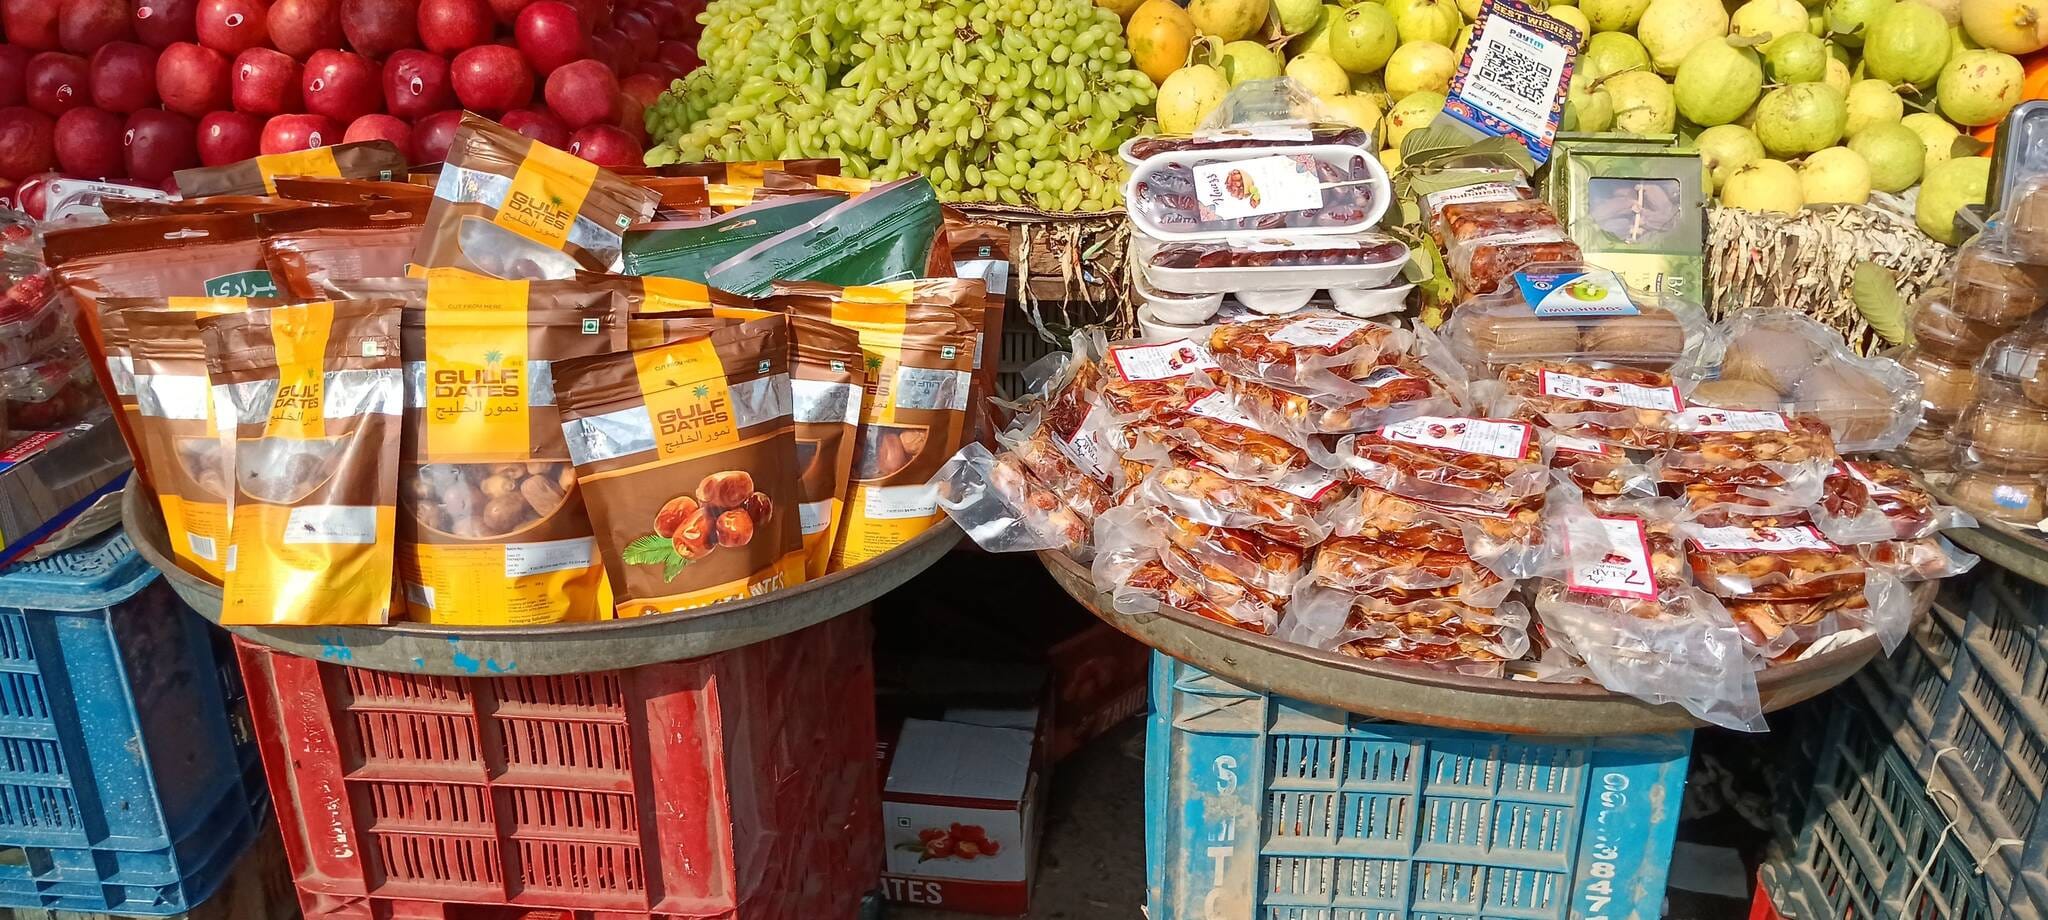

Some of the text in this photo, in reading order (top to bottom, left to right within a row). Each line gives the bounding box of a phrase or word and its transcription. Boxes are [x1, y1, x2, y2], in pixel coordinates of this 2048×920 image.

[1493, 3, 1574, 42] BEST WISHES
[508, 201, 566, 230] DATES
[512, 191, 571, 220] GULF
[434, 369, 519, 385] GULF
[279, 383, 319, 398] GULF
[435, 385, 519, 398] DATES
[274, 397, 319, 409] DATES
[435, 399, 519, 420] تمور الخليج
[657, 398, 725, 425] GULF
[660, 411, 729, 436] DATES
[664, 426, 731, 454] تمور الخليج
[1625, 569, 1646, 586] 7
